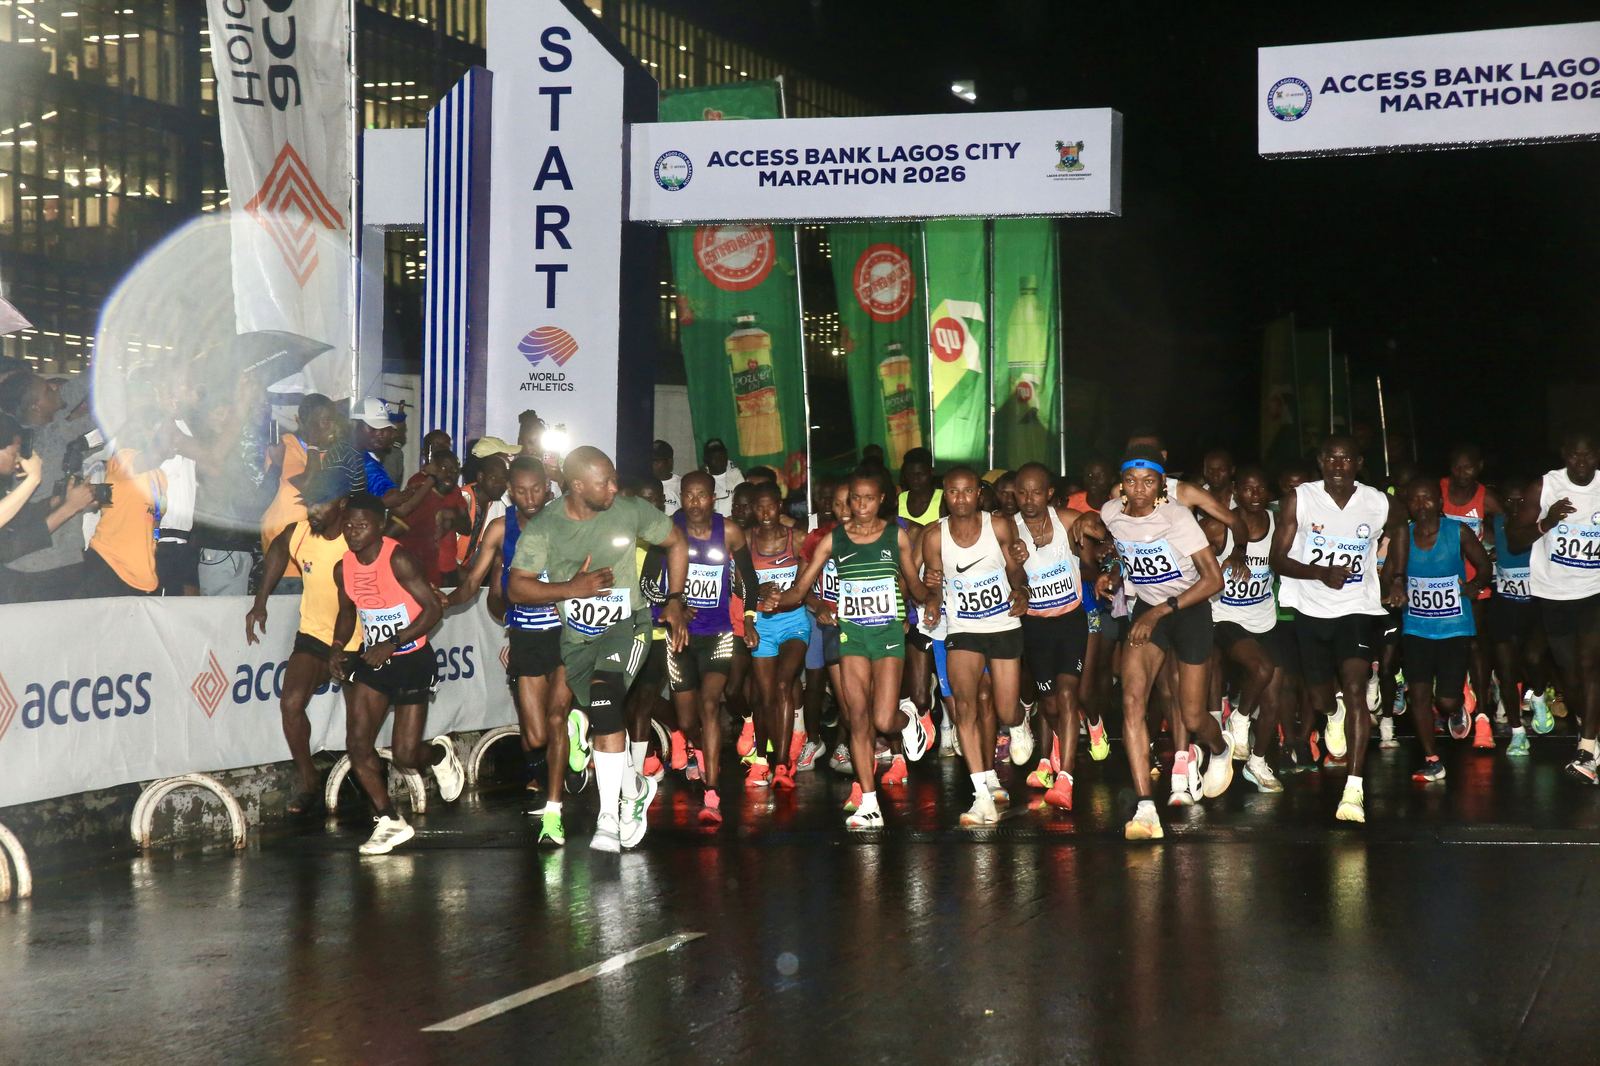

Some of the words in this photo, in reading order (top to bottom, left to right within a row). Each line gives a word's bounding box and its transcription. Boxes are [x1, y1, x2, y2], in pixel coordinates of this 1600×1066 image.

[1320, 69, 1427, 94] ACCESS
[1435, 63, 1513, 87] BANK
[1380, 84, 1543, 113] MARATHON
[707, 149, 798, 168] ACCESS
[804, 145, 872, 165] BANK
[878, 143, 960, 163] LAGOS
[964, 141, 1021, 161] CITY
[533, 26, 574, 308] START
[758, 167, 898, 187] MARATHON
[903, 165, 966, 184] 2026
[519, 382, 574, 391] ATHLETICS
[529, 372, 566, 381] WORLD
[1136, 546, 1163, 555] access
[1337, 543, 1366, 551] access
[1555, 536, 1600, 560] 3044
[1122, 555, 1172, 576] 6483
[1309, 548, 1363, 573] 2126
[692, 569, 718, 577] access
[771, 570, 795, 580] access
[974, 575, 999, 588] access
[1041, 566, 1066, 579] access
[861, 584, 889, 593] access
[1225, 577, 1269, 599] 3907
[1428, 581, 1454, 589] access
[1500, 578, 1530, 596] 261
[595, 595, 623, 603] access
[844, 594, 890, 616] BIRU
[958, 584, 1003, 612] 3569
[1412, 589, 1456, 609] 6505
[375, 612, 402, 622] access
[570, 599, 622, 627] 3024
[21, 671, 152, 728] access
